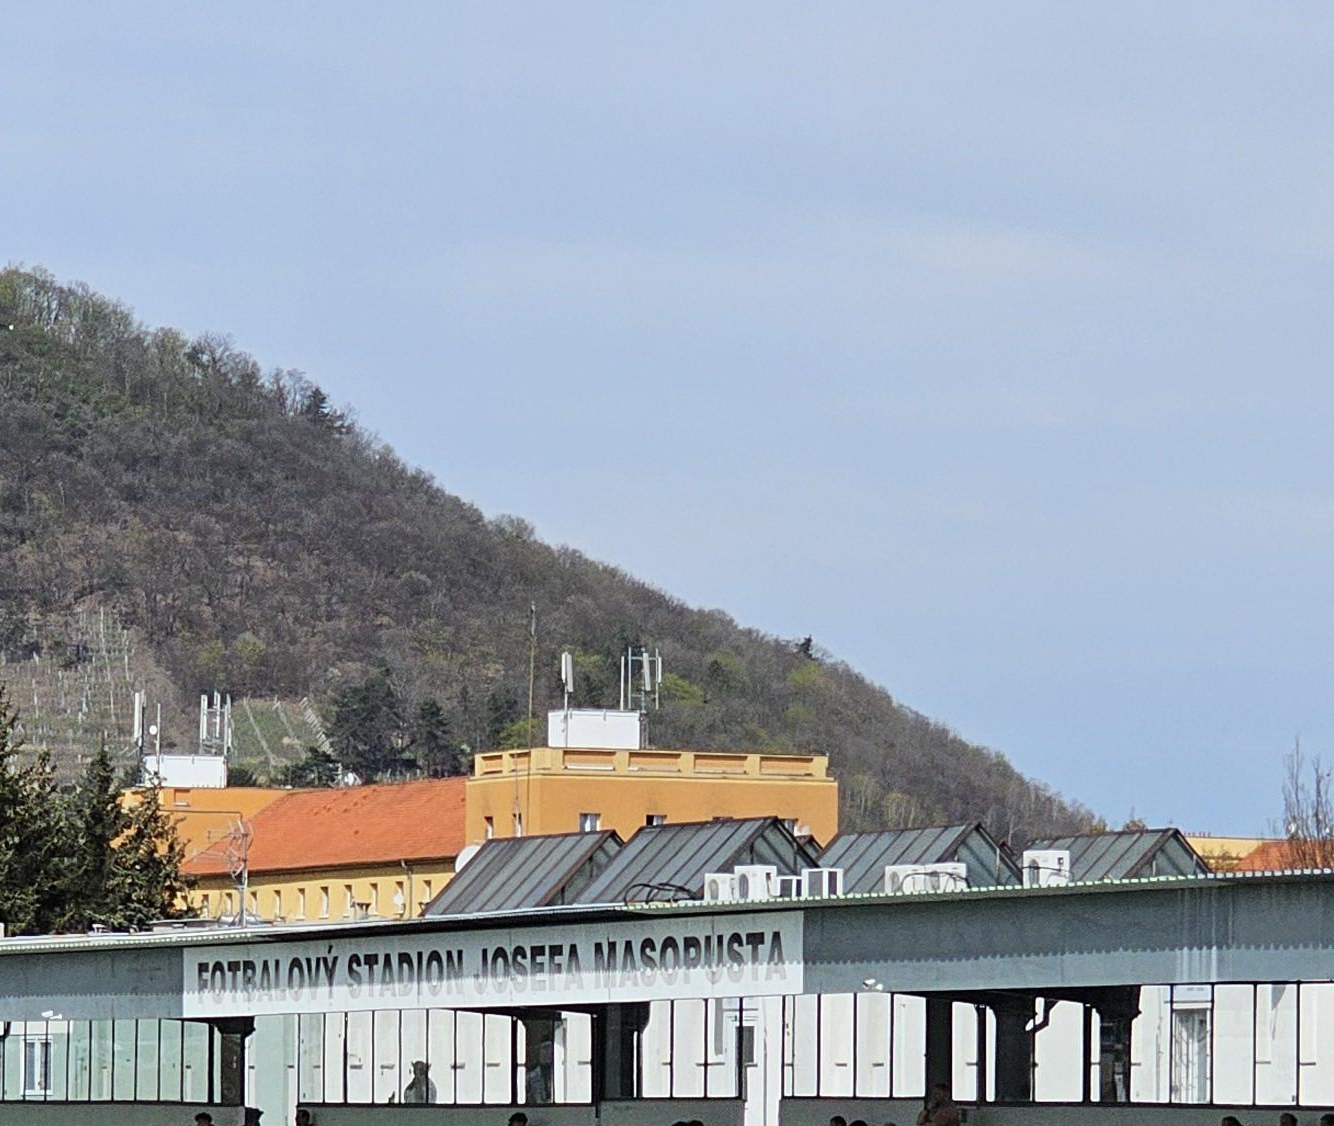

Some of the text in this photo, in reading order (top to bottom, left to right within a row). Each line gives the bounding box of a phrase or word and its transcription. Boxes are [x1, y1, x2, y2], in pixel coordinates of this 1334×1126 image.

[196, 931, 787, 1005] FOTBALOVÝ STADION JOSEFA MASOPUSTA
